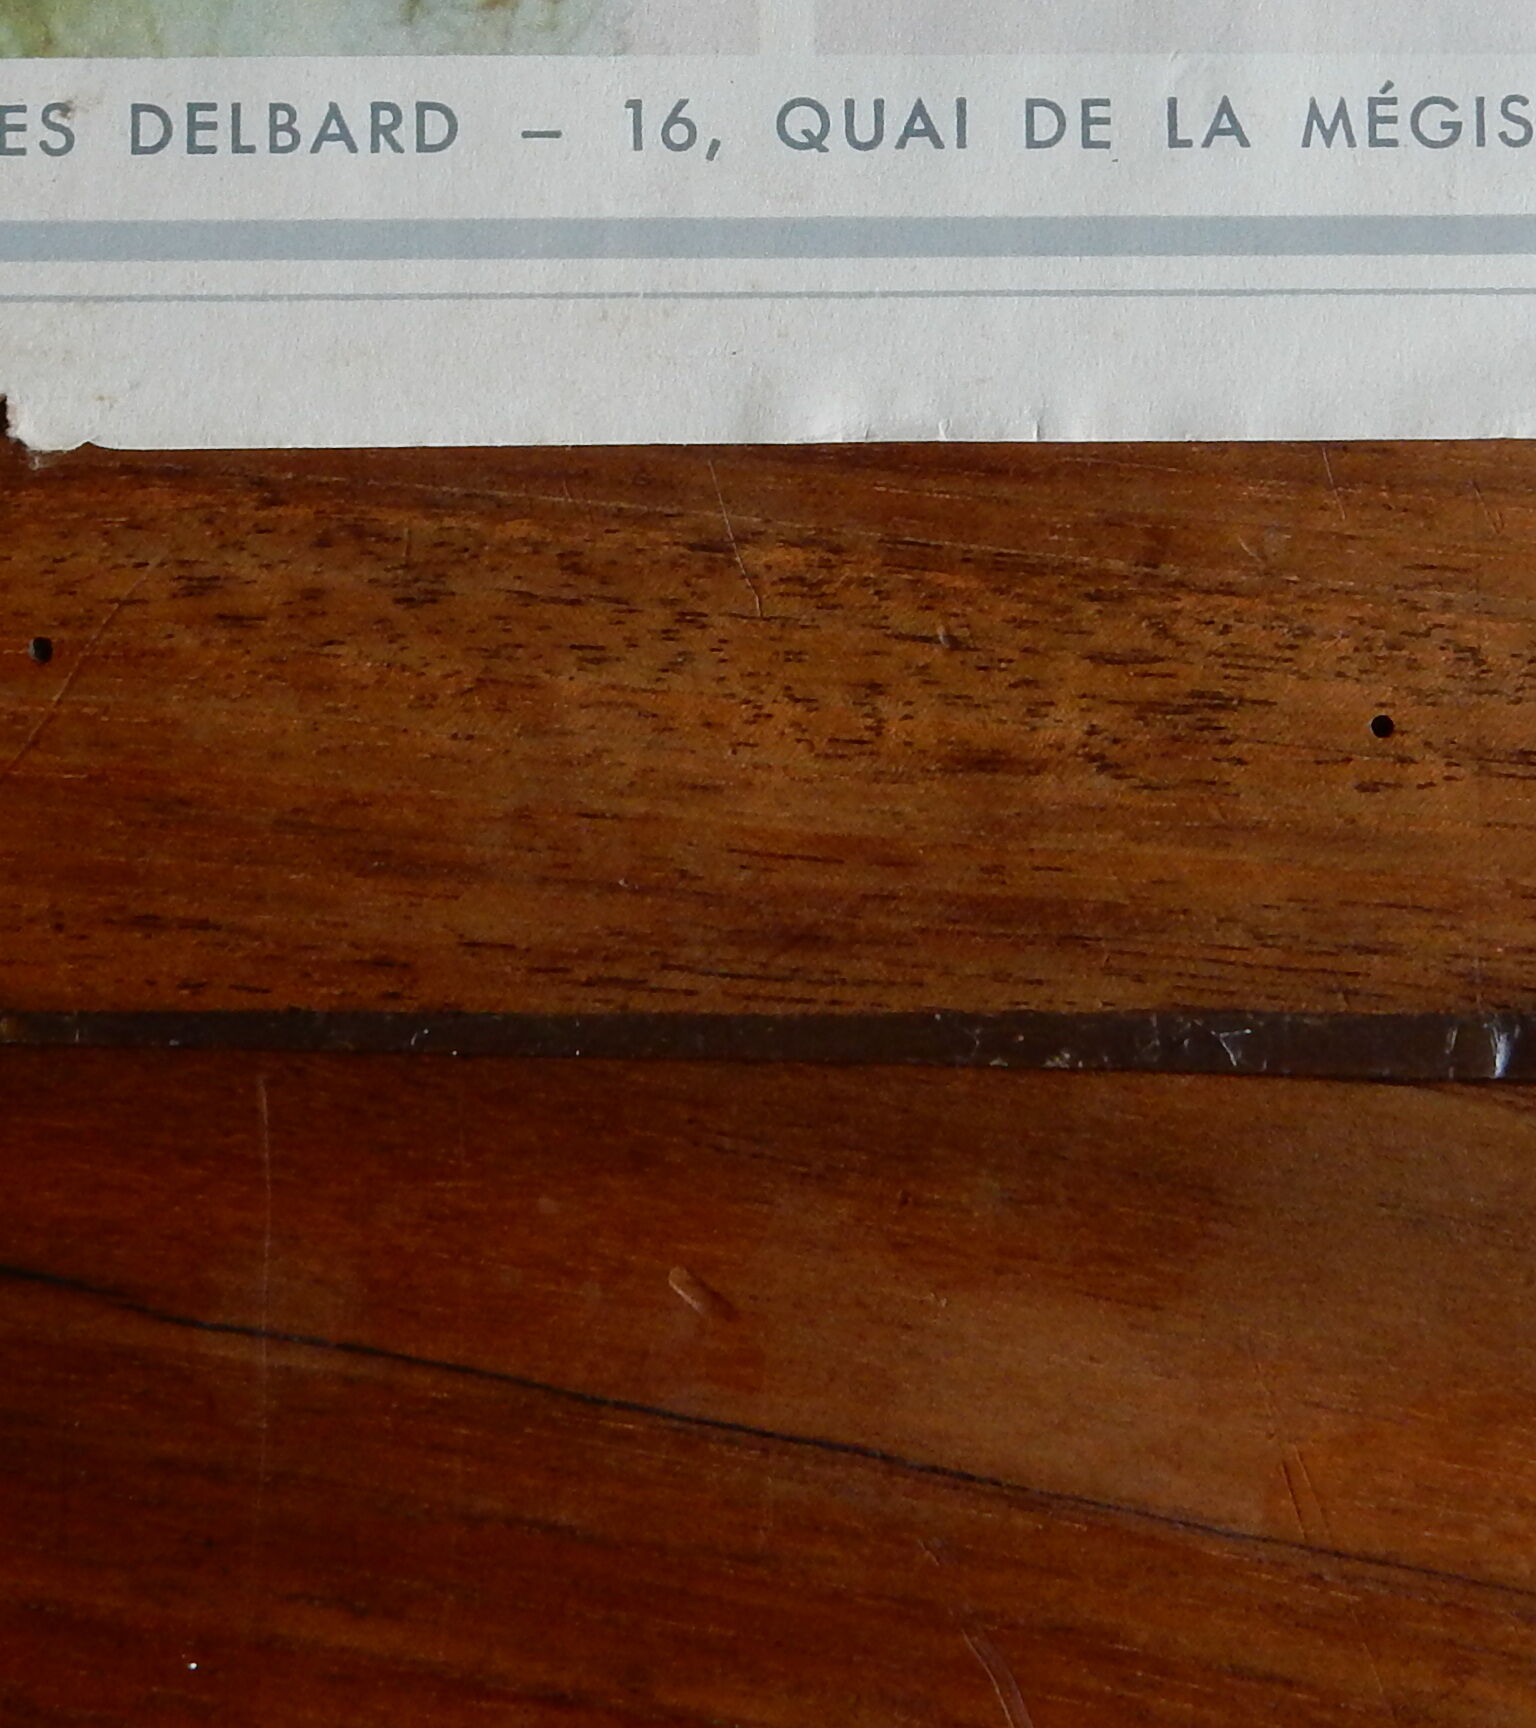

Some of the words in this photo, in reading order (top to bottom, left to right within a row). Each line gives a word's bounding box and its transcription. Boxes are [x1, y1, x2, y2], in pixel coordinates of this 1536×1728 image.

[130, 101, 459, 156] DELBARD
[623, 98, 722, 162] 16,
[775, 96, 968, 154] QUAI
[1024, 97, 1113, 150] DE
[1166, 94, 1252, 149] LA
